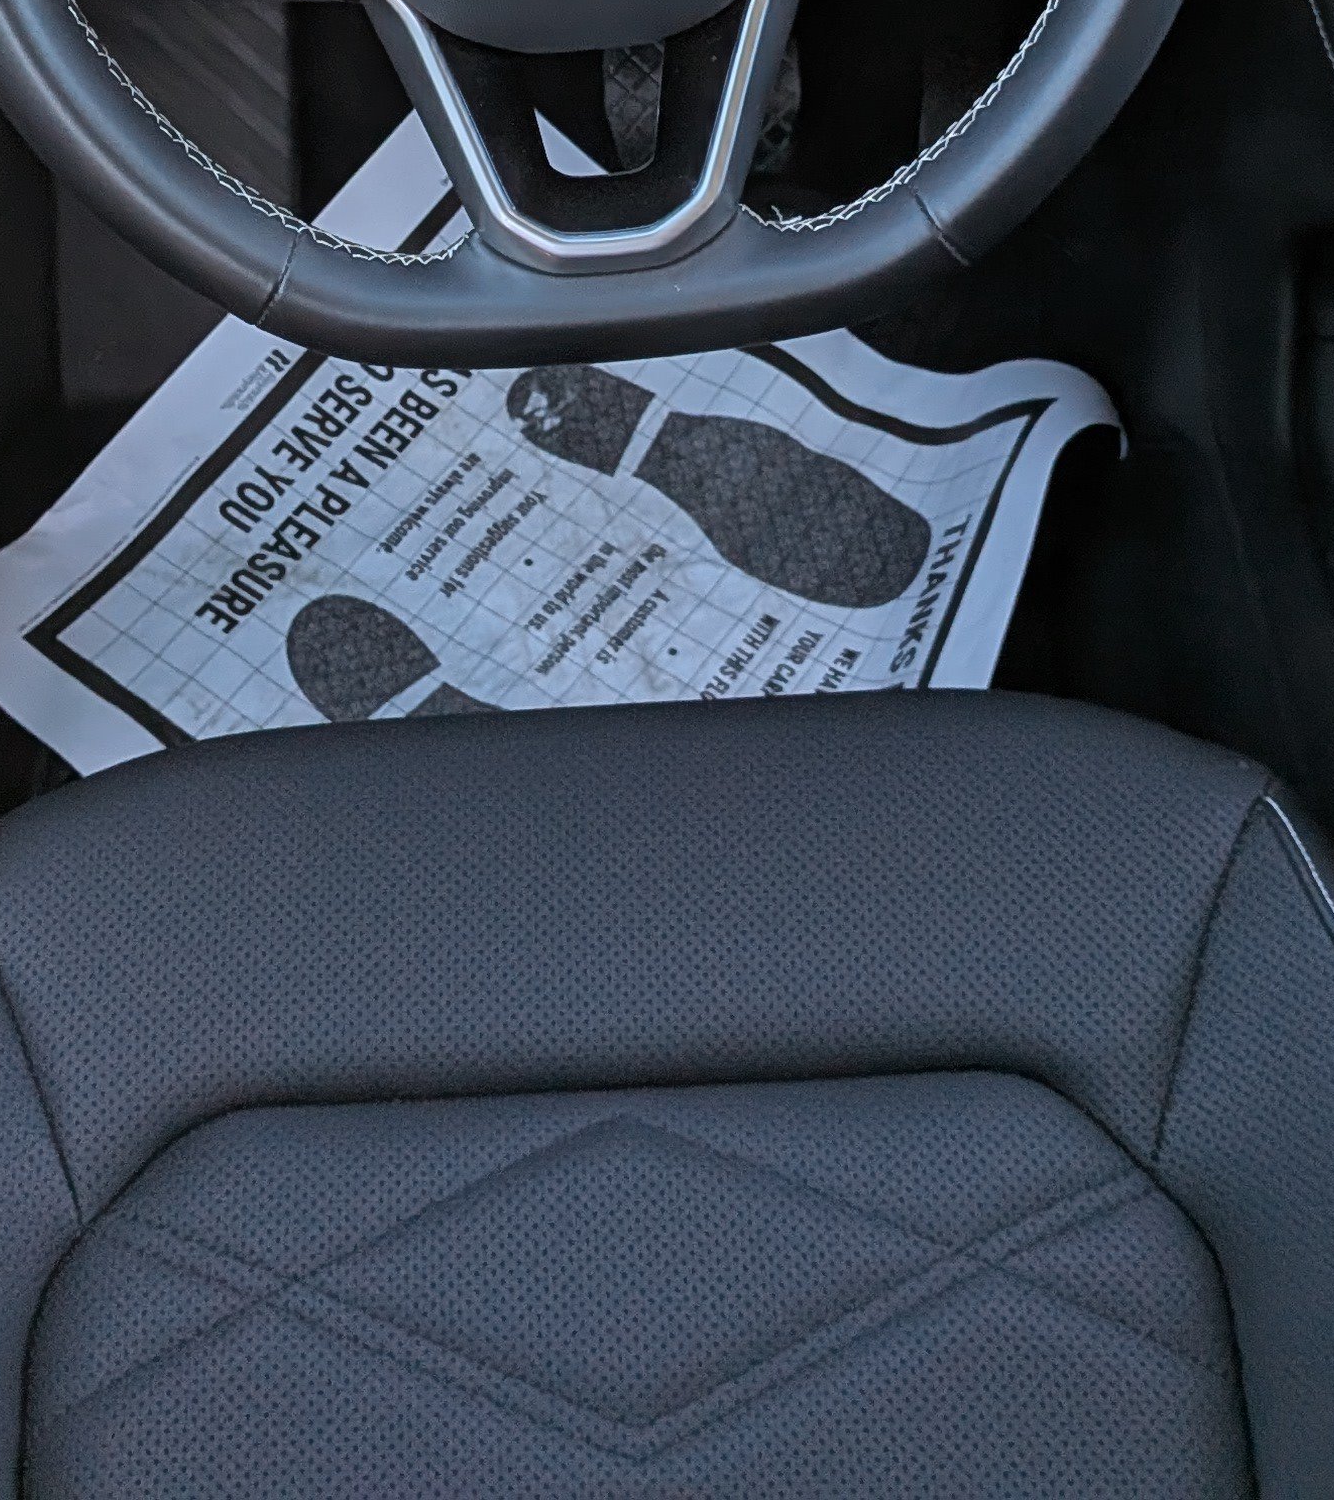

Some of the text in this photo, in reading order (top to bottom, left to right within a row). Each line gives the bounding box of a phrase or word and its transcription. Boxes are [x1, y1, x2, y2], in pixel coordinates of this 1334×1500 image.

[272, 374, 373, 472] SERVE
[353, 389, 439, 469] BEEN
[219, 465, 295, 533] YOU
[329, 458, 369, 488] A
[195, 483, 352, 634] PLEASURE
[890, 514, 972, 673] THANKS
[743, 614, 781, 650] WITH
[785, 630, 825, 665] YOUR
[700, 675, 730, 700] FLO
